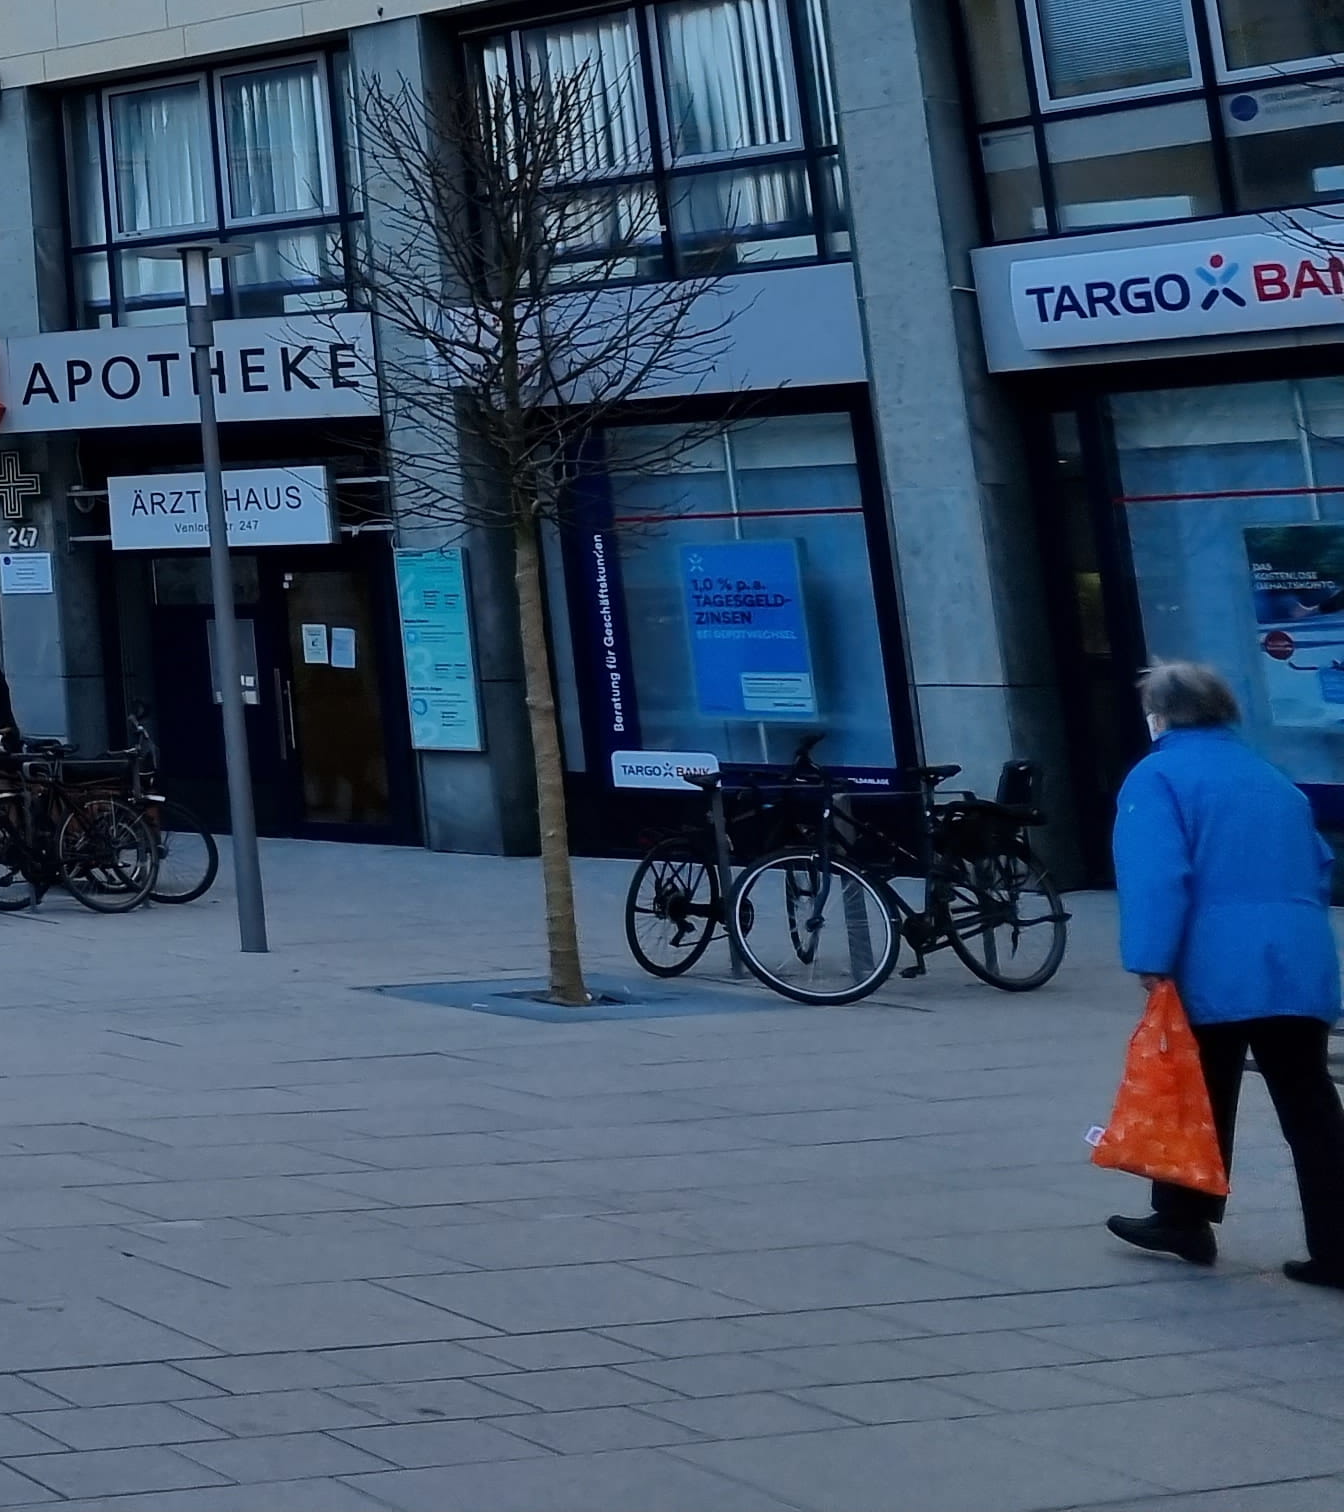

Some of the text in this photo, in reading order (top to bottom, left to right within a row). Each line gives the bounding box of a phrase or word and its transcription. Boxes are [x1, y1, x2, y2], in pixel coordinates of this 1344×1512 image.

[1026, 273, 1190, 322] TARGO
[22, 343, 360, 406] APOTHEKE
[131, 486, 303, 516] ÄRZTHAUS
[239, 520, 259, 531] 247
[7, 527, 38, 548] 247
[717, 577, 733, 591] %
[692, 594, 792, 607] TAGESGELD-
[695, 611, 753, 624] ZINSEN
[605, 651, 617, 669] für
[612, 672, 625, 732] Beratung
[621, 765, 661, 777] TARGO
